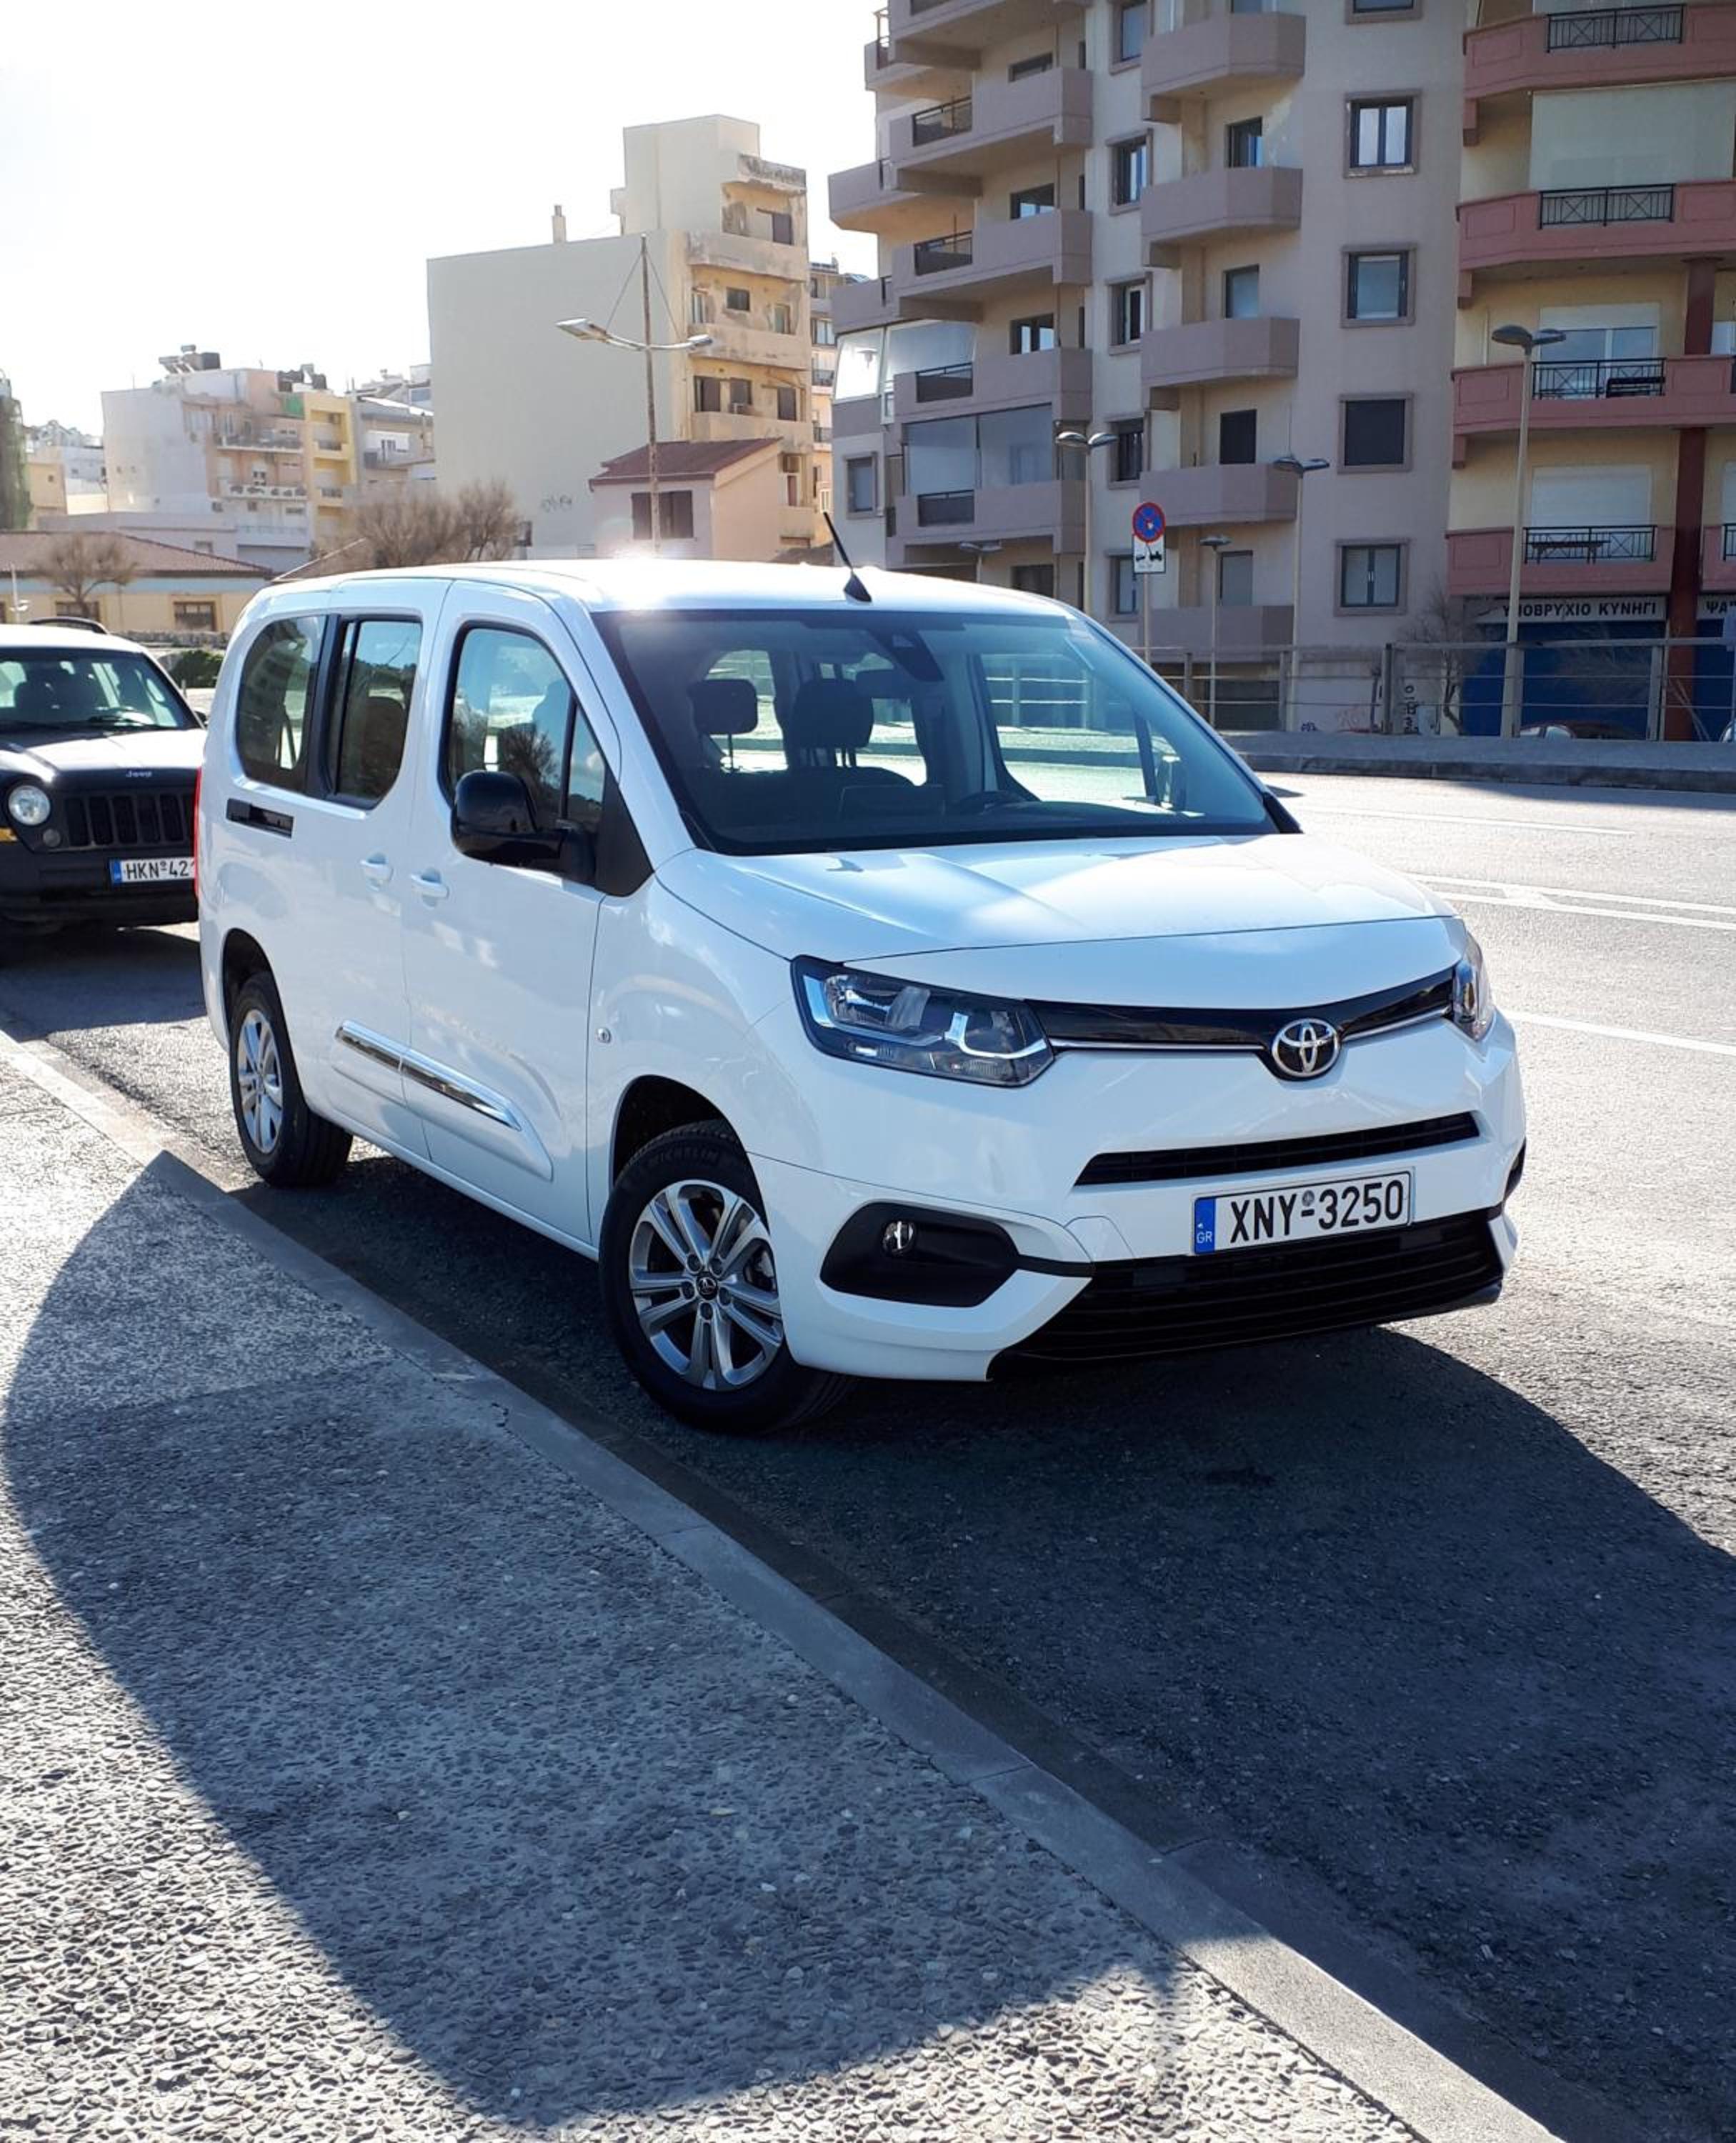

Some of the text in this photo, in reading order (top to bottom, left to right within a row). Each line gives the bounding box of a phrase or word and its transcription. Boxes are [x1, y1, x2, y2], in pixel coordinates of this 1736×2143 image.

[1502, 602, 1657, 617] ΥΟΒΡΥΧΙΟ ΚΥΝΗΓΙ
[126, 860, 195, 880] HKN-42
[1229, 1179, 1405, 1244] XNY-3250
[1196, 1230, 1213, 1244] GR
